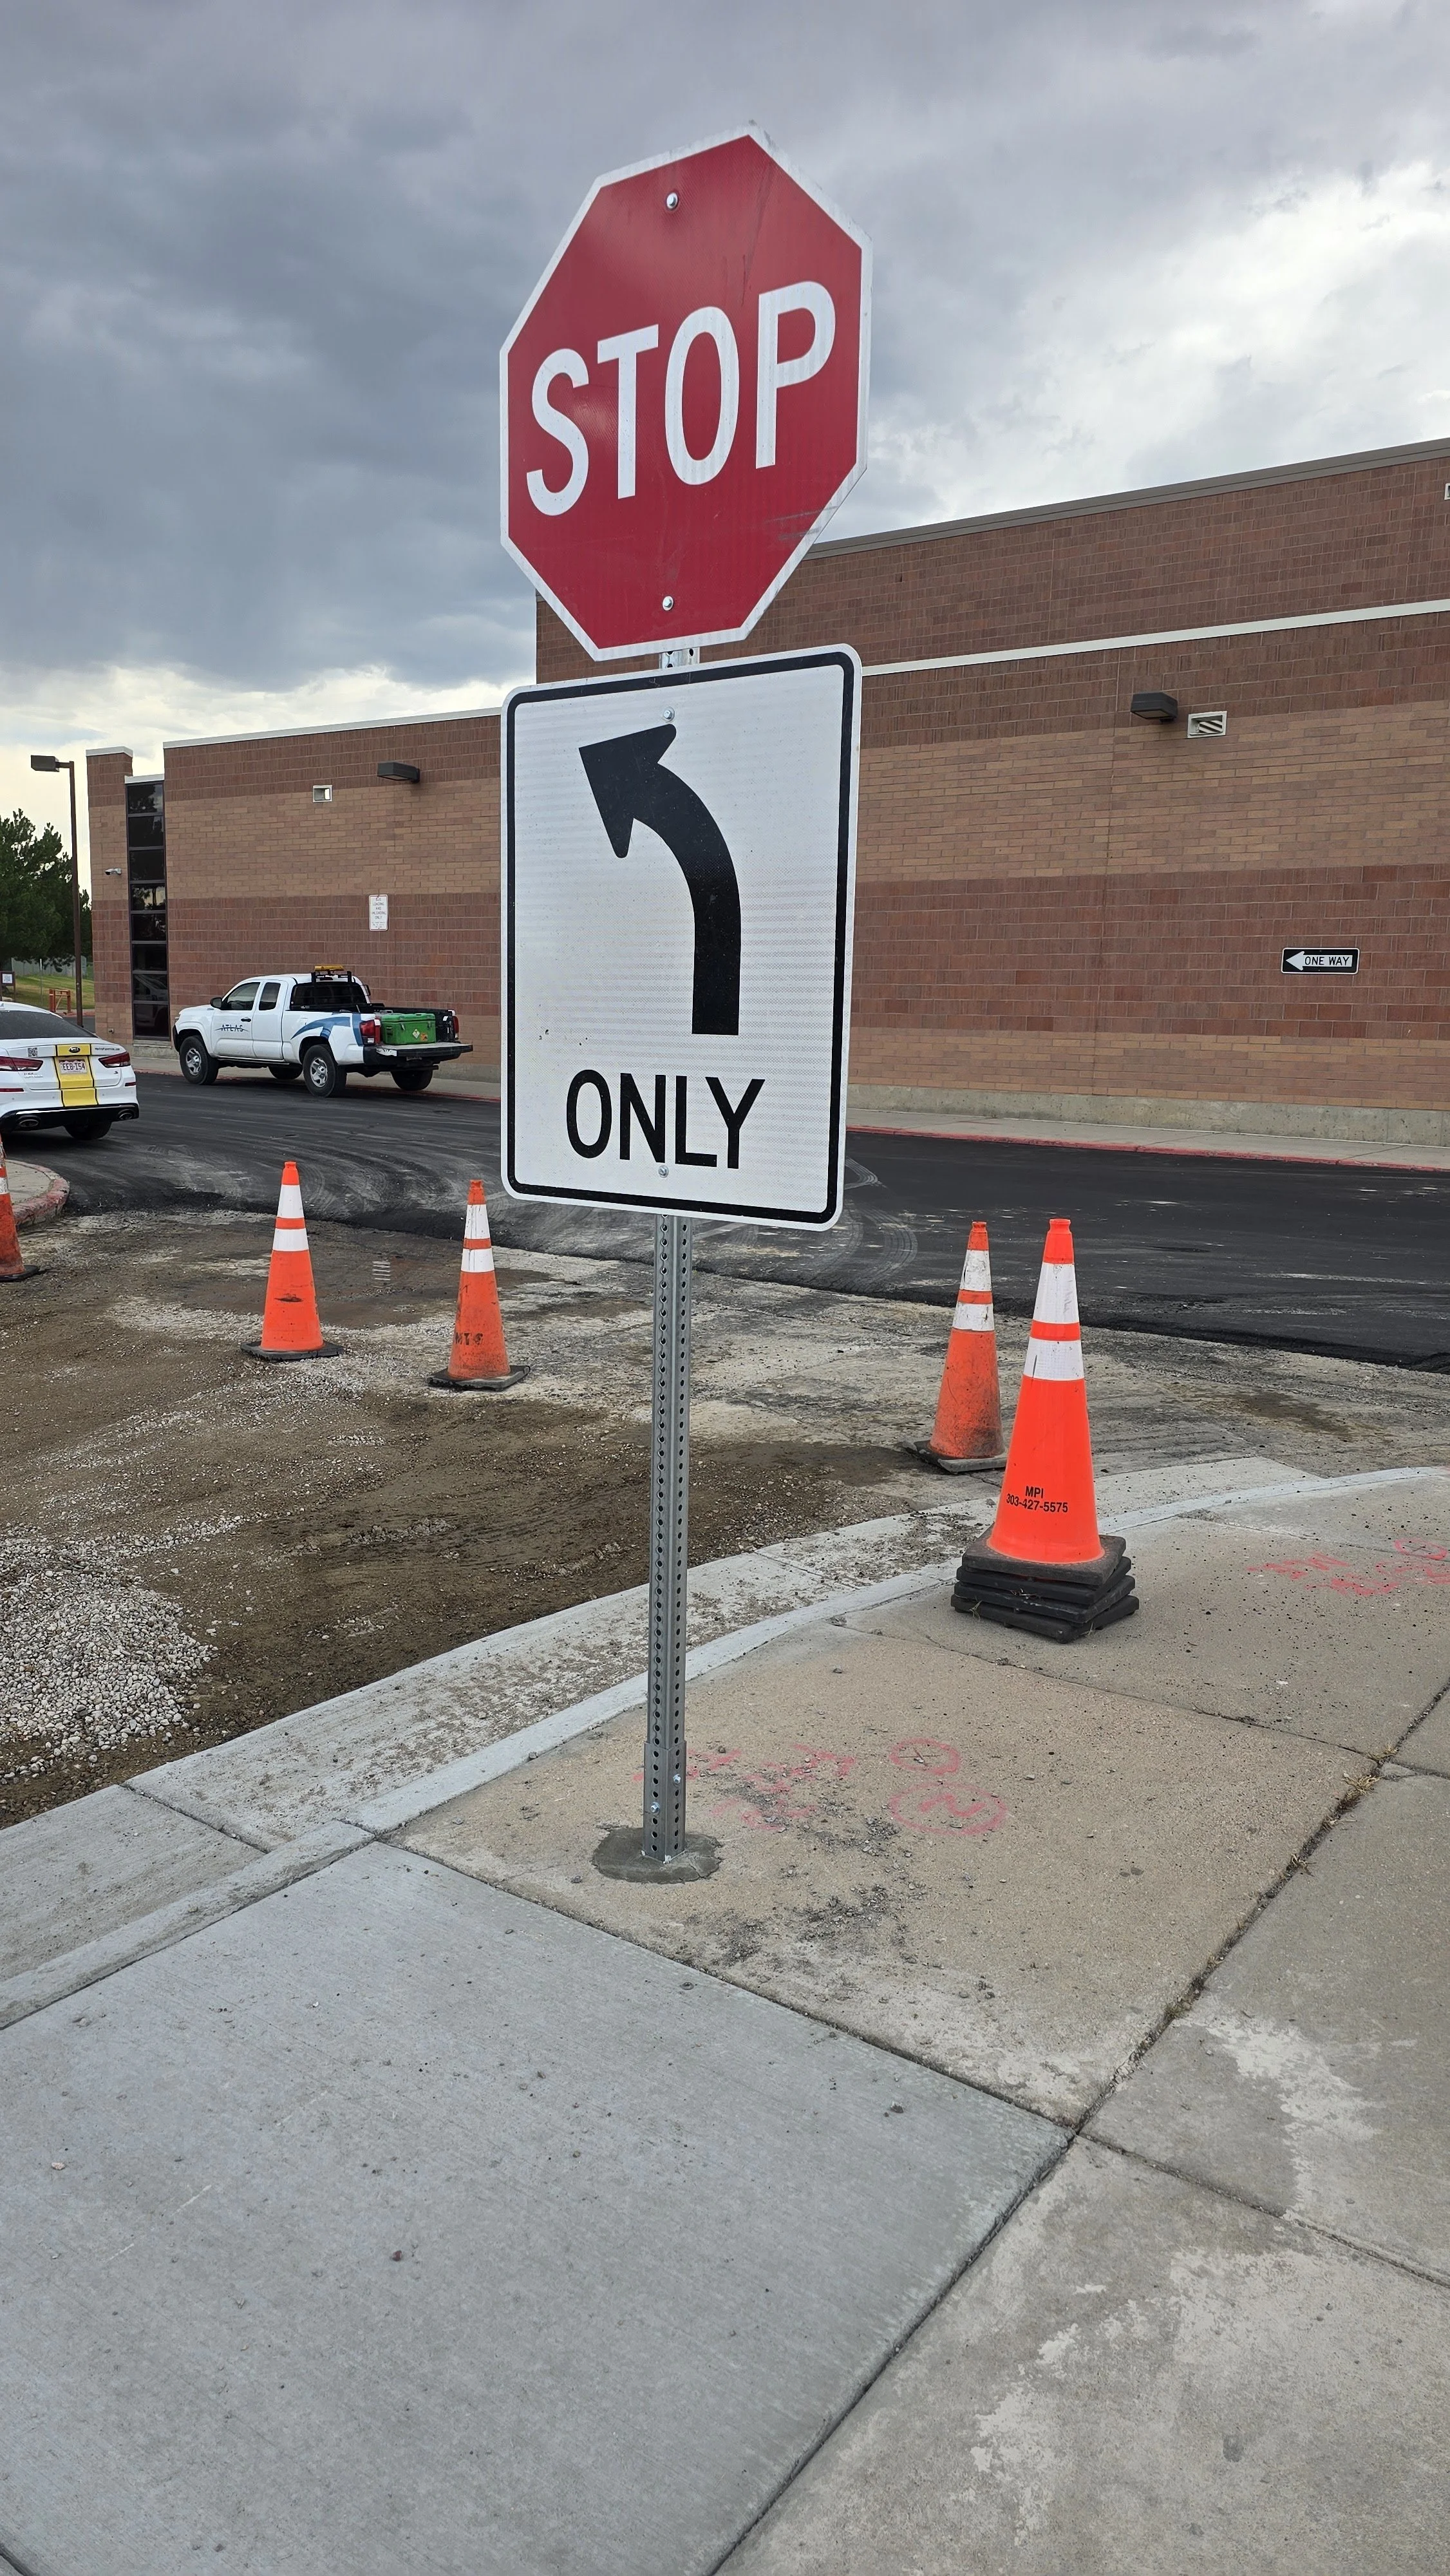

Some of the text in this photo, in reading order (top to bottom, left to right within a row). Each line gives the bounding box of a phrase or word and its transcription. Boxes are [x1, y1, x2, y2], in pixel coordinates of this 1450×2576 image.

[525, 280, 836, 516] STOP
[1304, 956, 1350, 966] ONE WAY
[566, 1068, 766, 1170] ONLY
[1025, 1485, 1044, 1499] MPI
[1006, 1493, 1068, 1513] 303-427-5575
